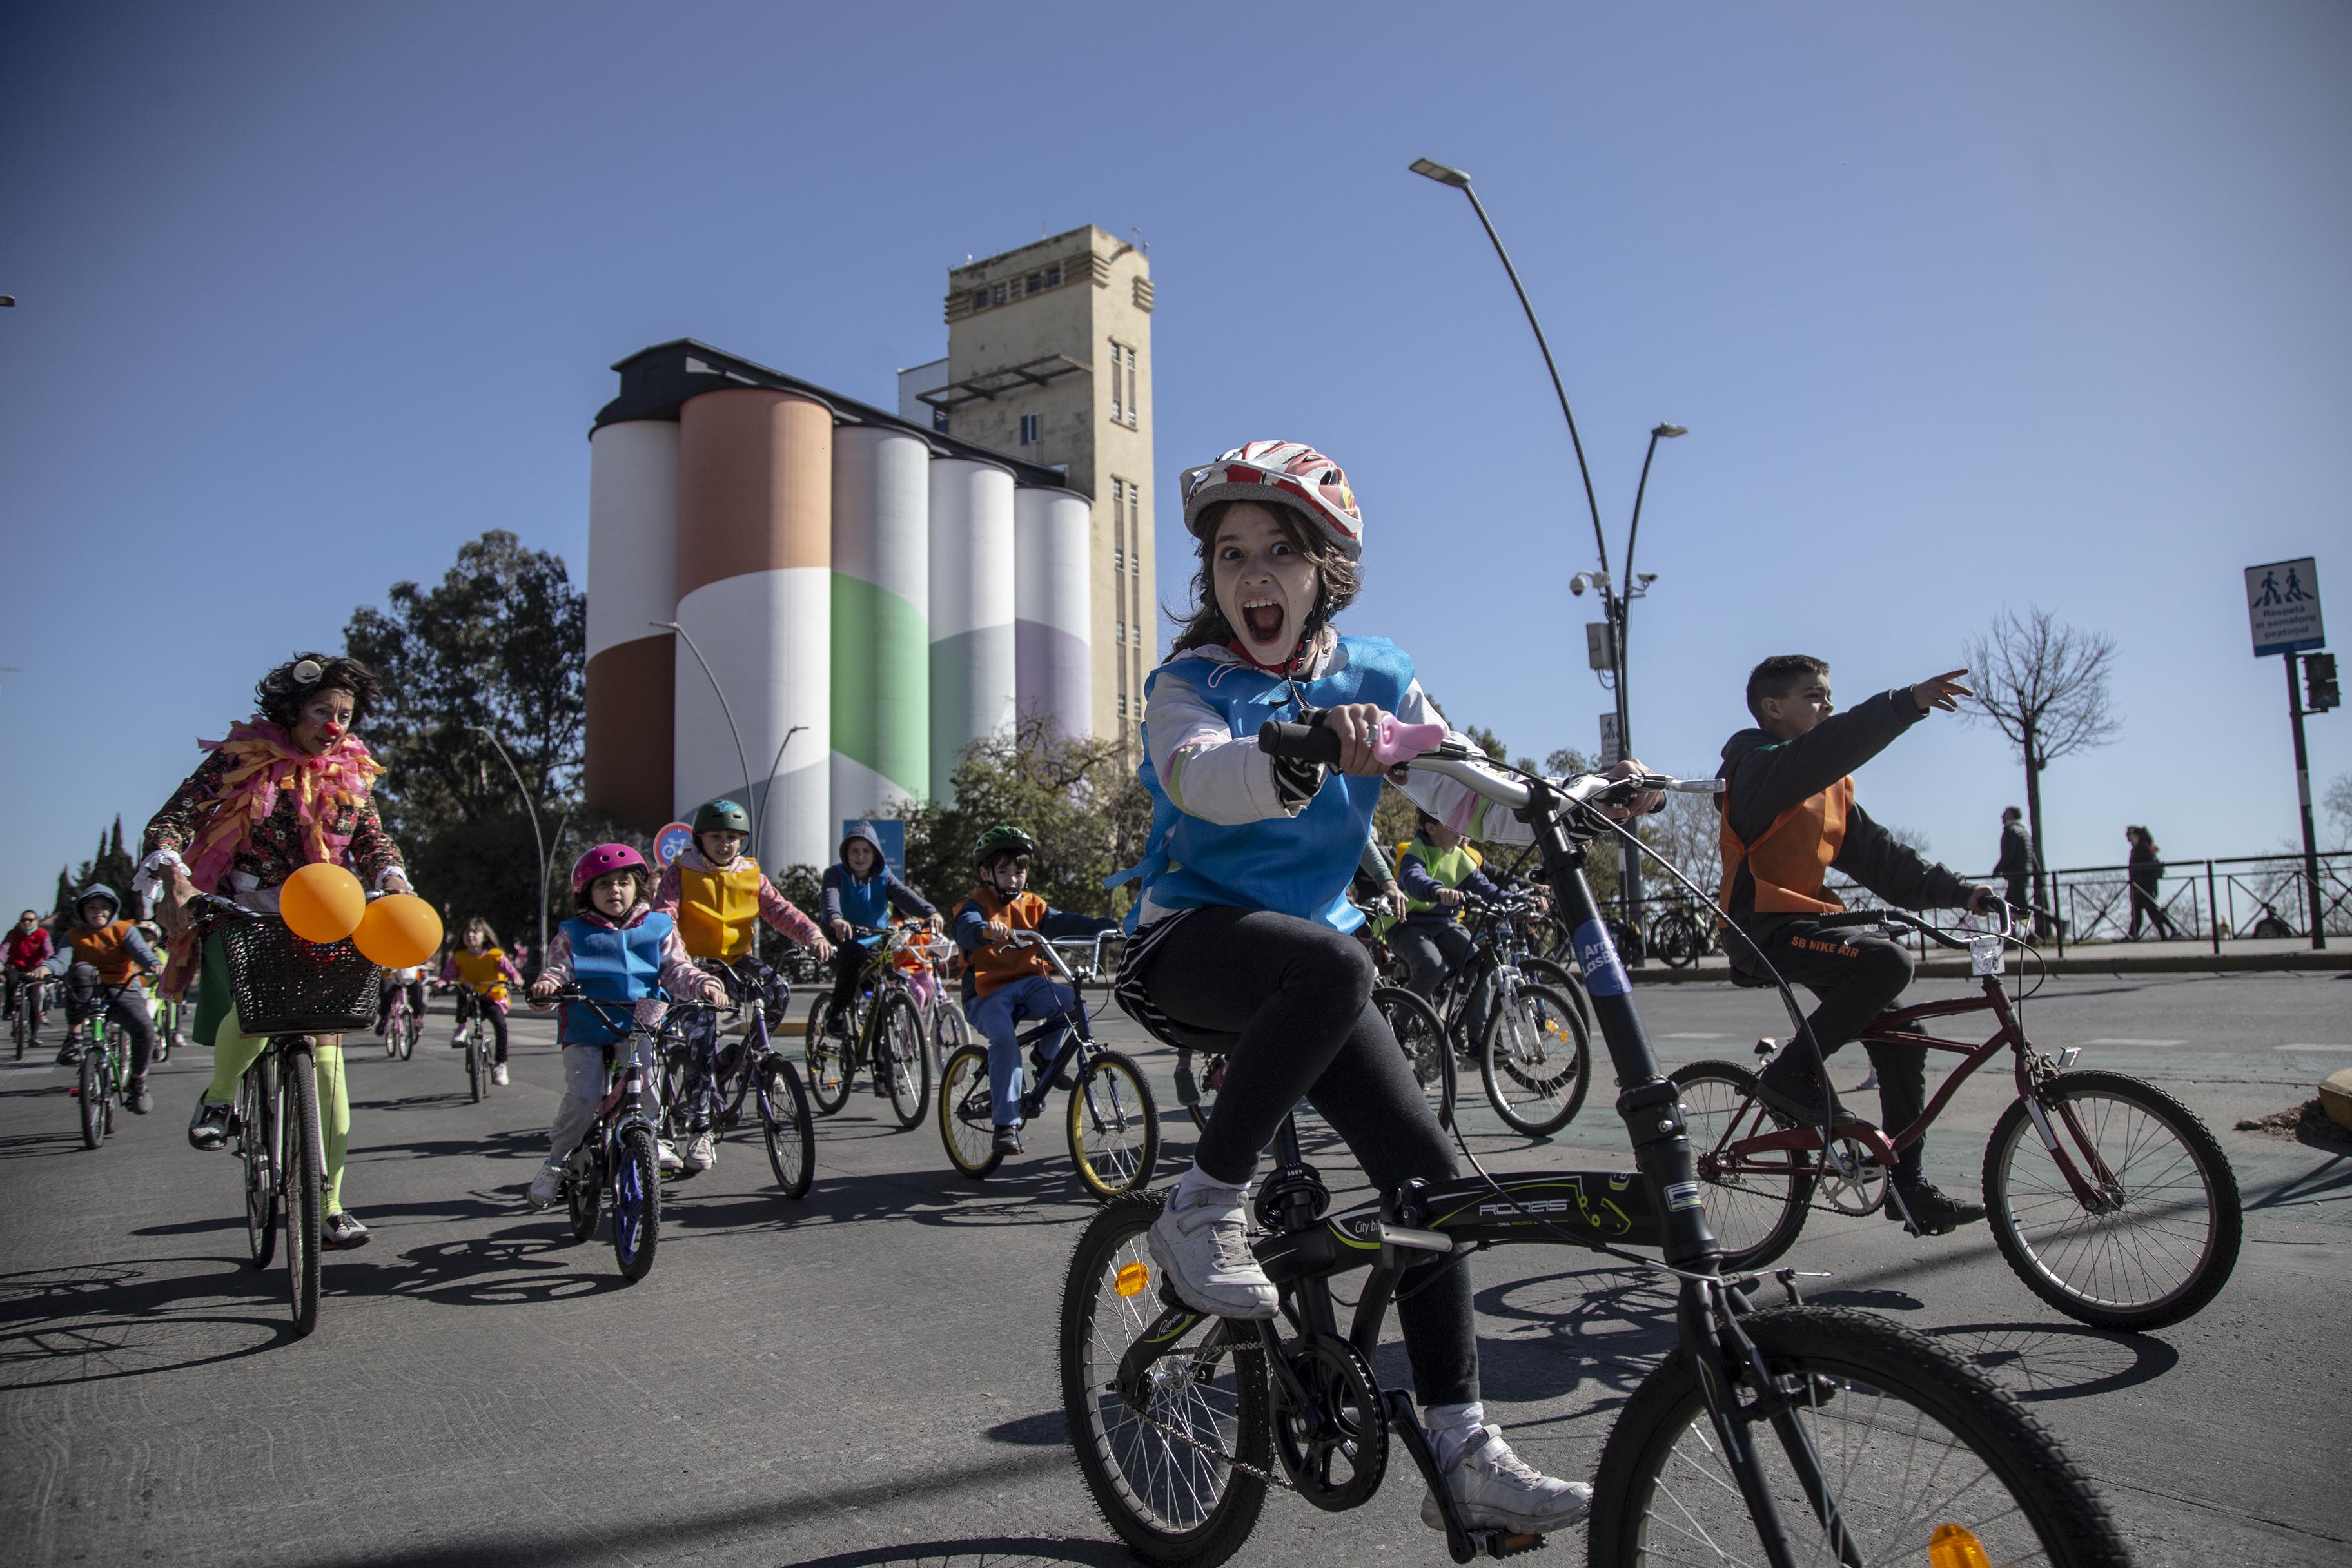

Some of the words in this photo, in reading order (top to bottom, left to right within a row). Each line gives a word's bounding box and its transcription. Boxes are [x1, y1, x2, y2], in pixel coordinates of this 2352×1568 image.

[1792, 936, 1806, 948] SB
[1809, 940, 1837, 952] NIKE
[1838, 945, 1859, 958] AIR
[1355, 1221, 1370, 1235] City
